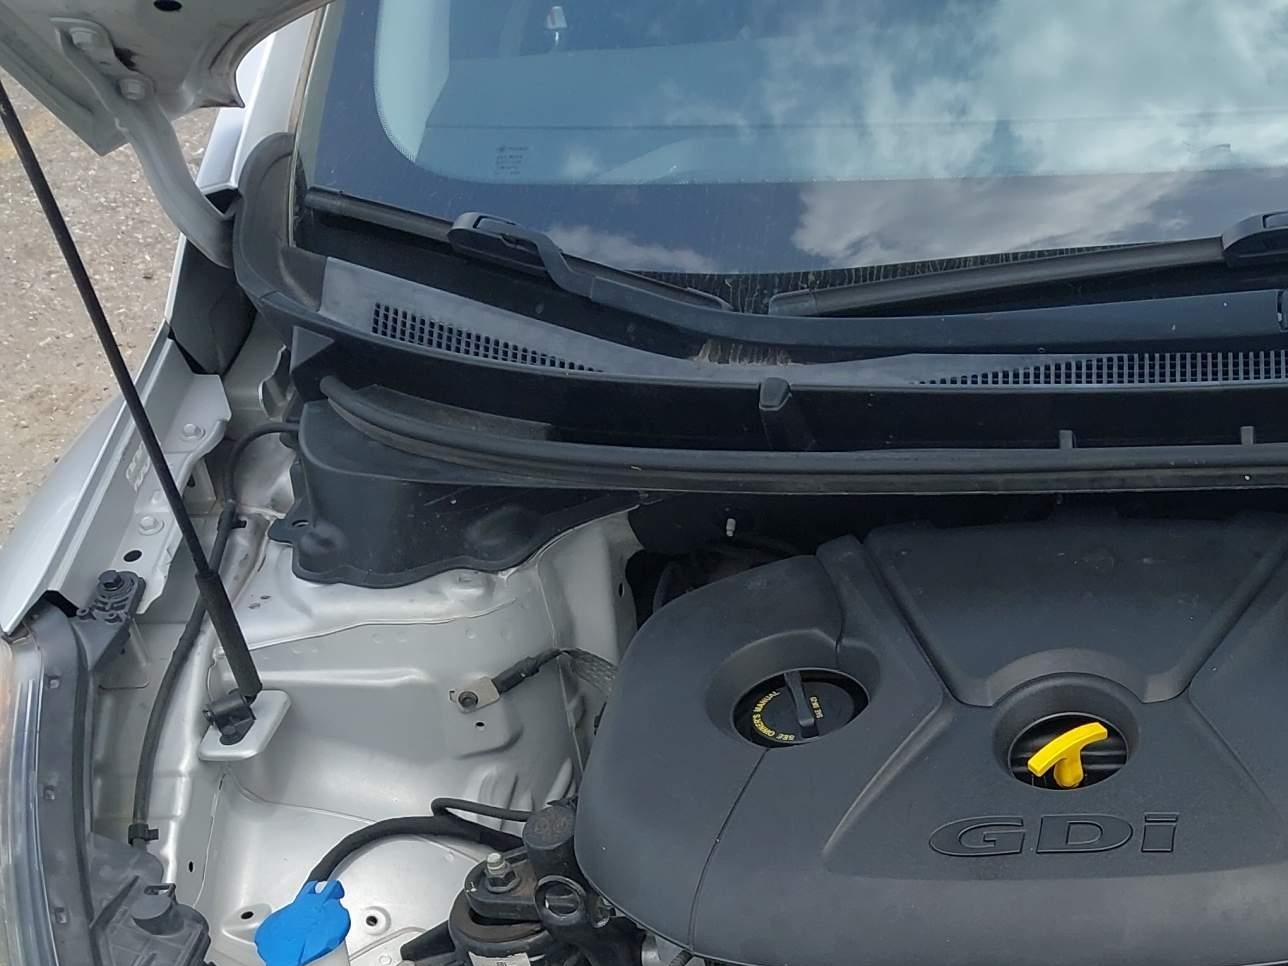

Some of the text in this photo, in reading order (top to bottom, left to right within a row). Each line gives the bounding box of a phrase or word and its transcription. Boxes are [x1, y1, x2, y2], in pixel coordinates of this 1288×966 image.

[753, 690, 781, 713] MANUAL
[776, 733, 796, 741] SEE
[929, 811, 1180, 858] GDi
